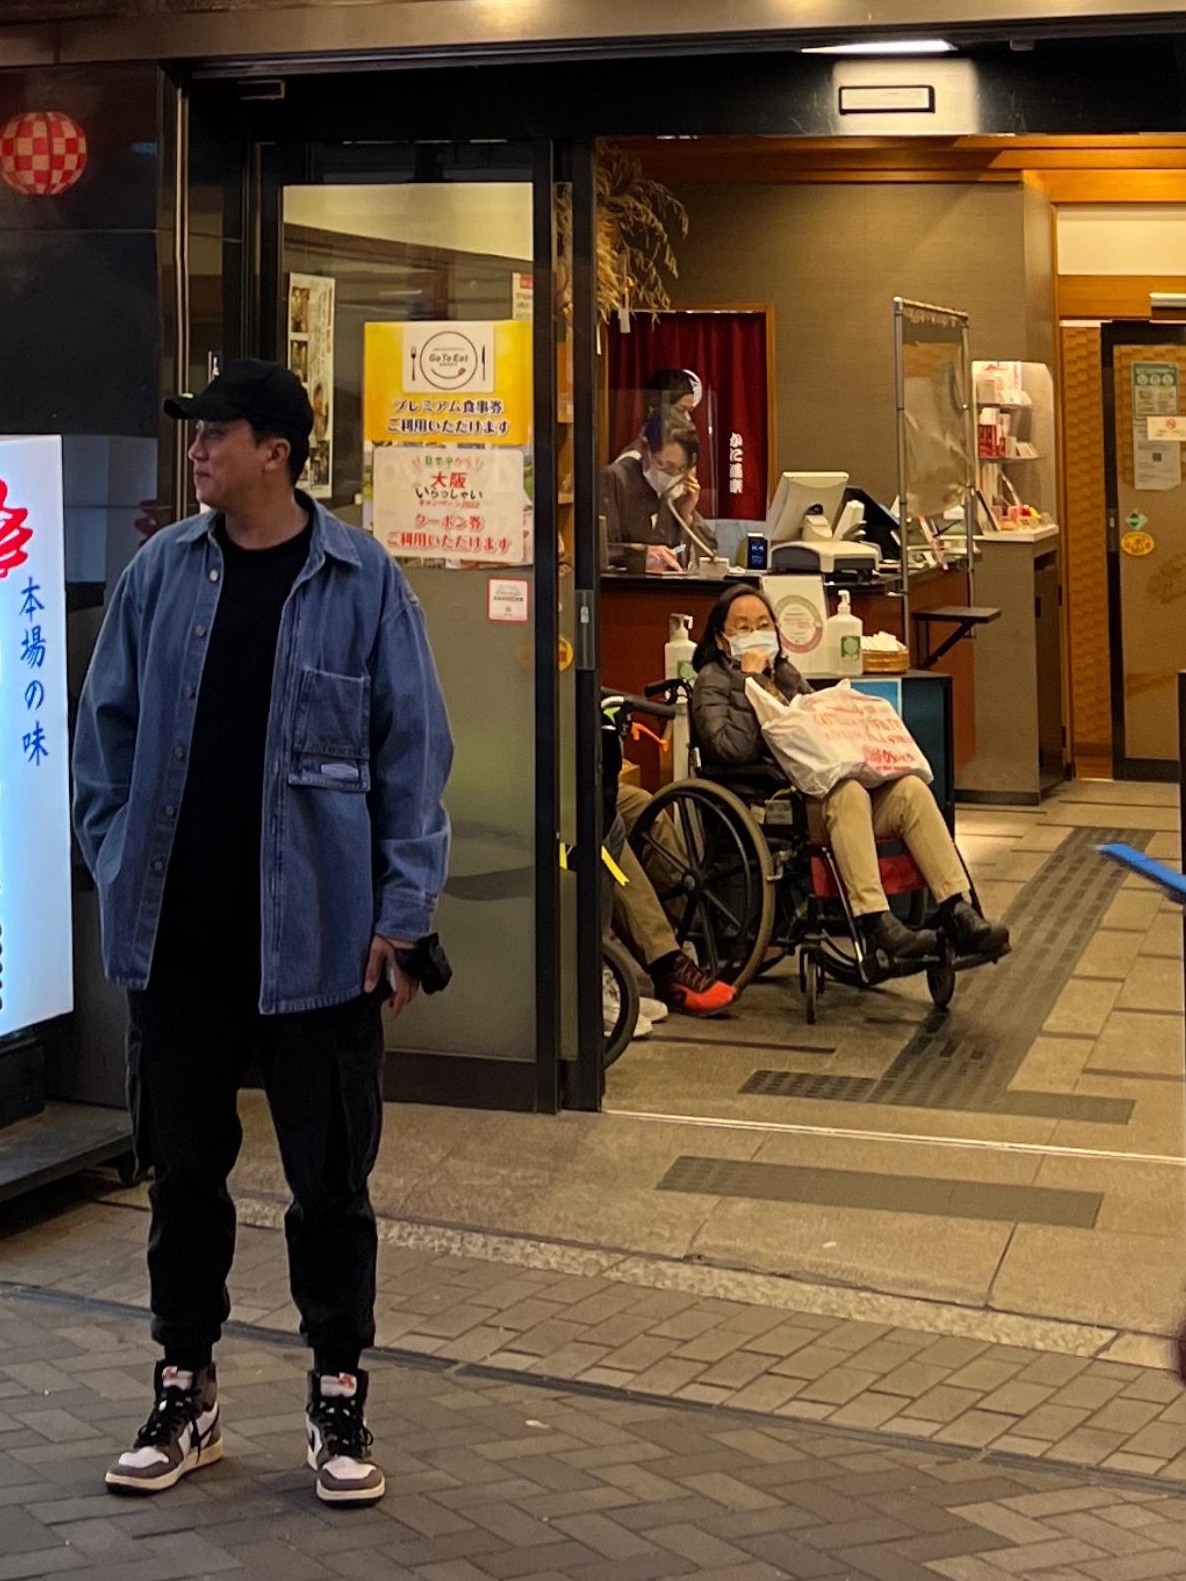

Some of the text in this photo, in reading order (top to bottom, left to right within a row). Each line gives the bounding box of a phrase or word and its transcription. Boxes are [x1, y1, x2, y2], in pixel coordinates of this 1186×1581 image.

[393, 399, 503, 415] プレミアム食事券
[388, 419, 509, 435] ご利用いただけます
[430, 471, 468, 489] 大阪
[415, 487, 483, 501] いらっしゃい
[415, 513, 485, 531] クーポン券
[387, 531, 512, 553] ご利用いただけます
[19, 576, 49, 767] 本場の味
